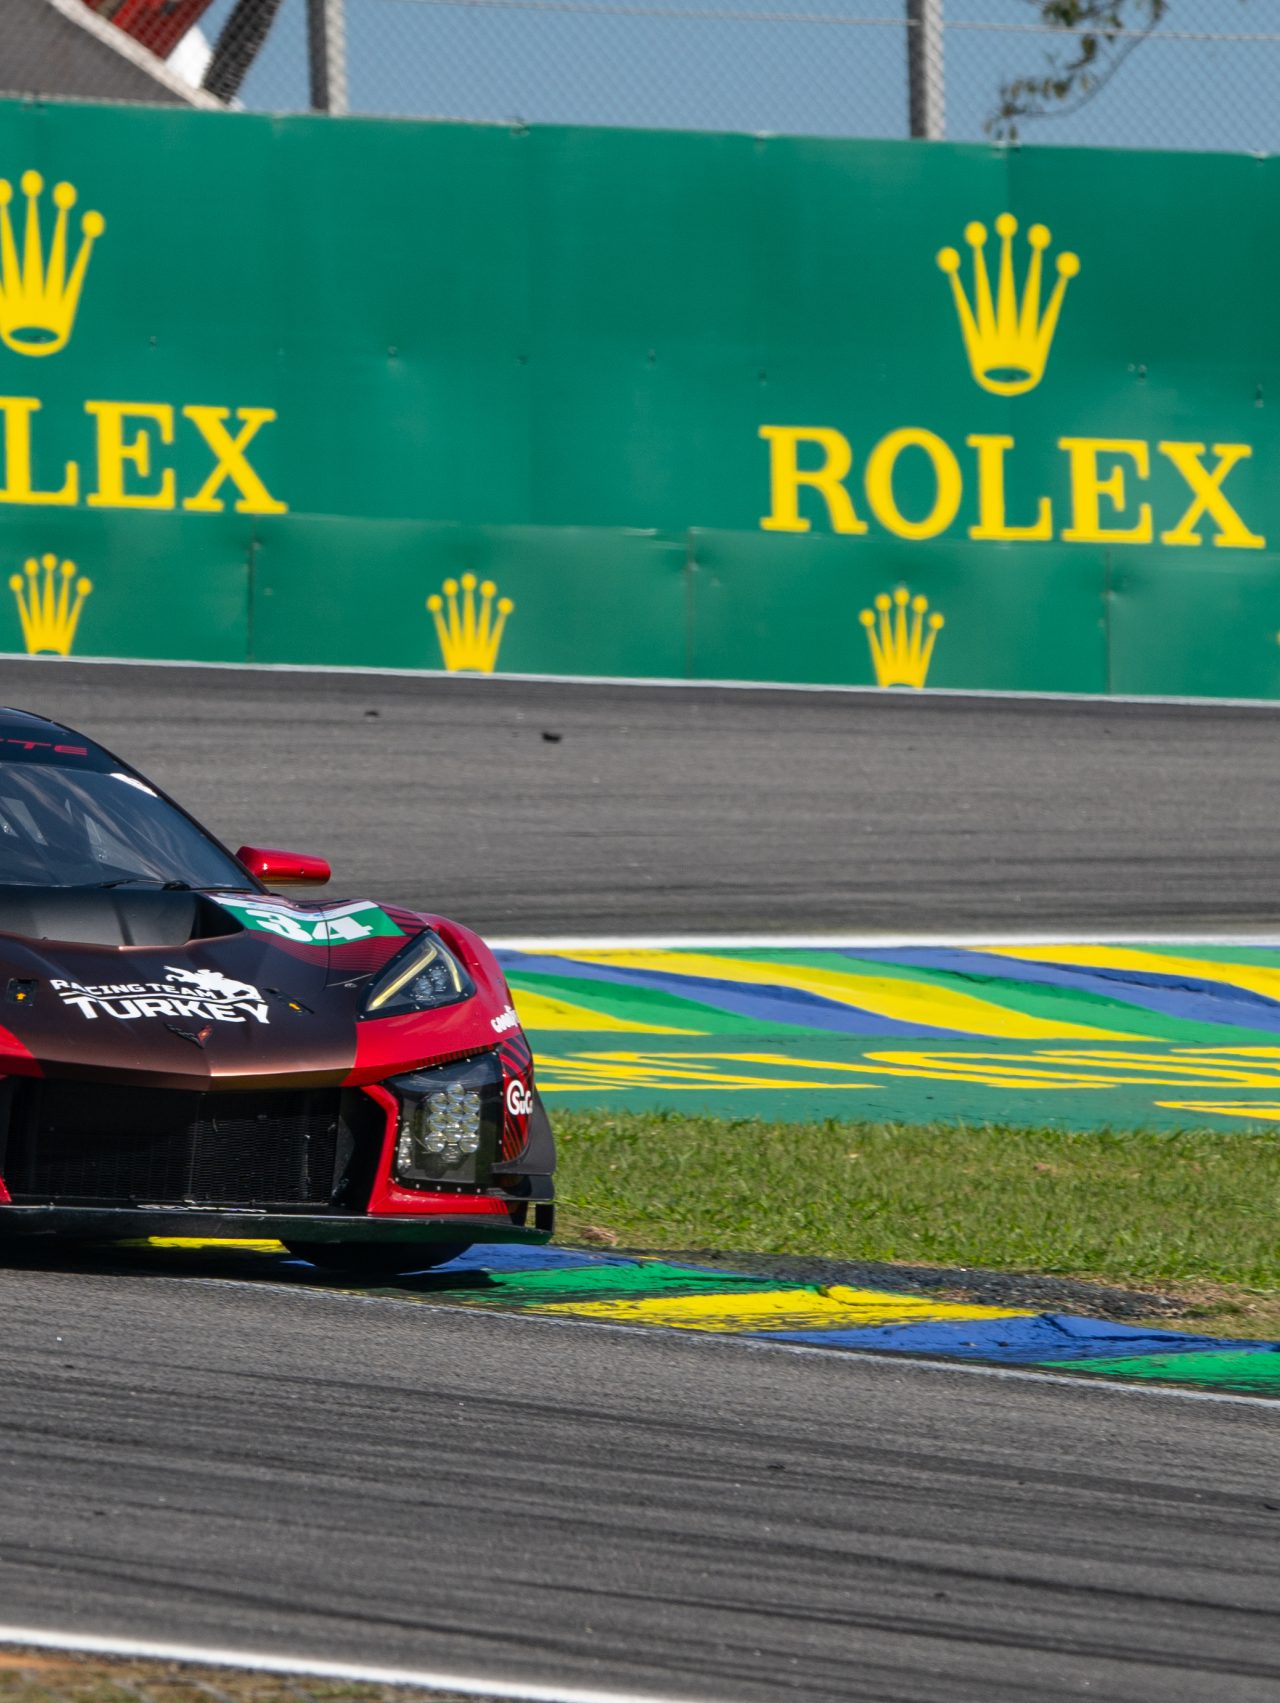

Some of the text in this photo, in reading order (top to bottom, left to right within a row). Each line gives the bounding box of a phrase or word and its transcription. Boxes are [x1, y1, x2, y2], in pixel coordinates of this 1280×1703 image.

[759, 425, 1266, 549] ROLEX
[245, 908, 374, 943] 34
[49, 979, 218, 999] RACING TEAM
[63, 998, 270, 1024] TURKEY
